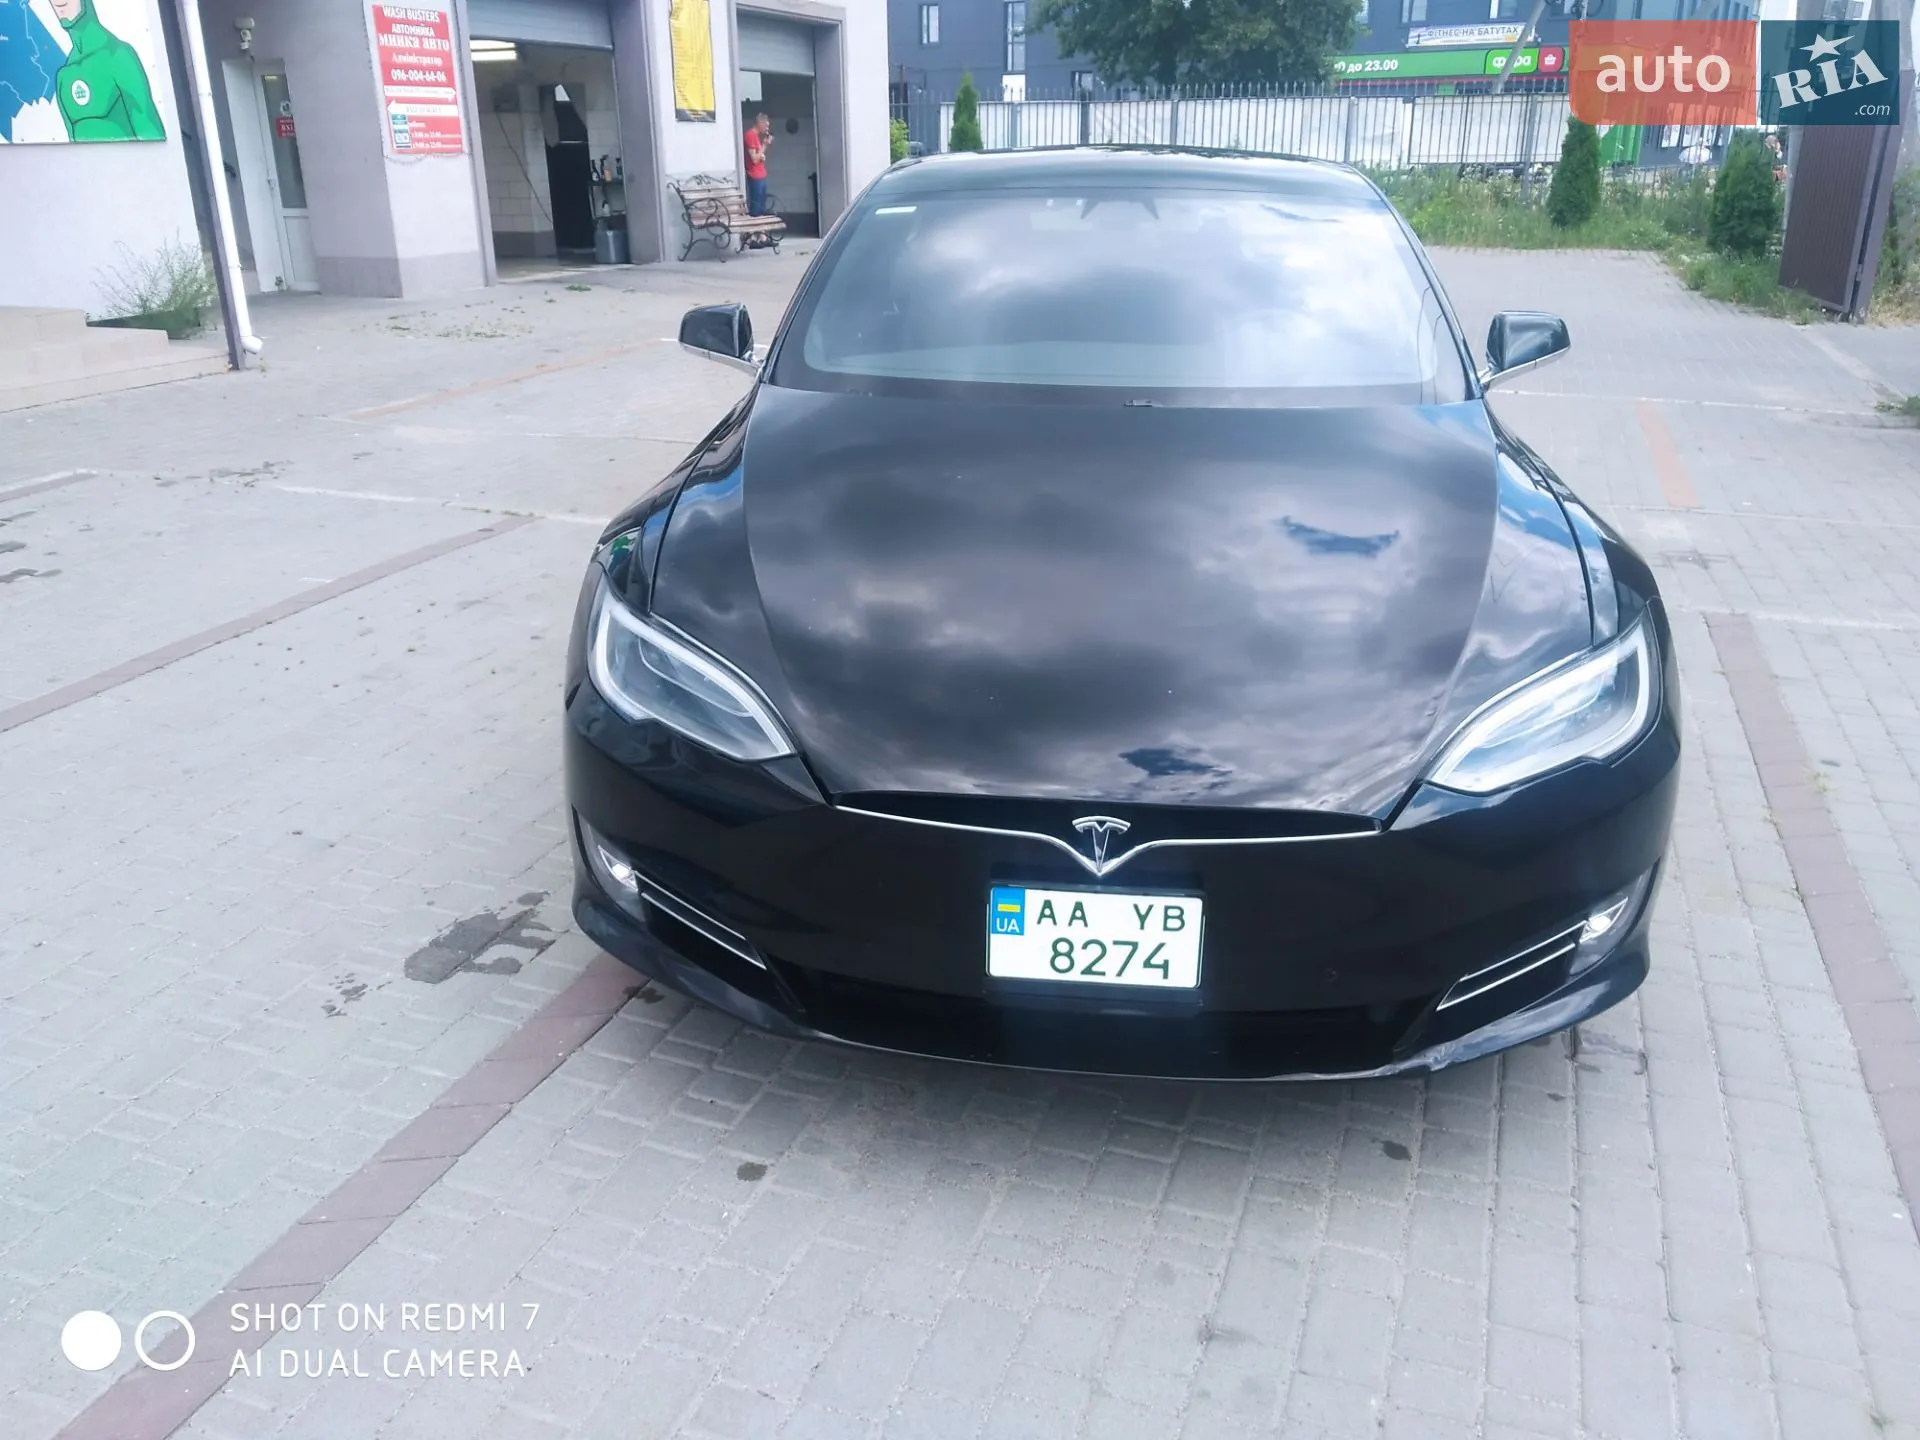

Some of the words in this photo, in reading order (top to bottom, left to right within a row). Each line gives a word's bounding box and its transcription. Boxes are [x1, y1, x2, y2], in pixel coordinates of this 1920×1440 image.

[382, 5, 405, 19] WASH
[407, 8, 440, 23] BUSTERS
[1427, 28, 1460, 37] ФІТНЕС
[1462, 28, 1475, 36] НА
[1477, 26, 1519, 36] БАТУТАХ
[1347, 62, 1362, 74] до
[1364, 59, 1399, 72] 23.00
[1492, 55, 1532, 69] фра
[996, 916, 1020, 933] UA
[1036, 899, 1089, 929] AA
[1132, 903, 1186, 933] YB
[1049, 936, 1171, 980] 8274
